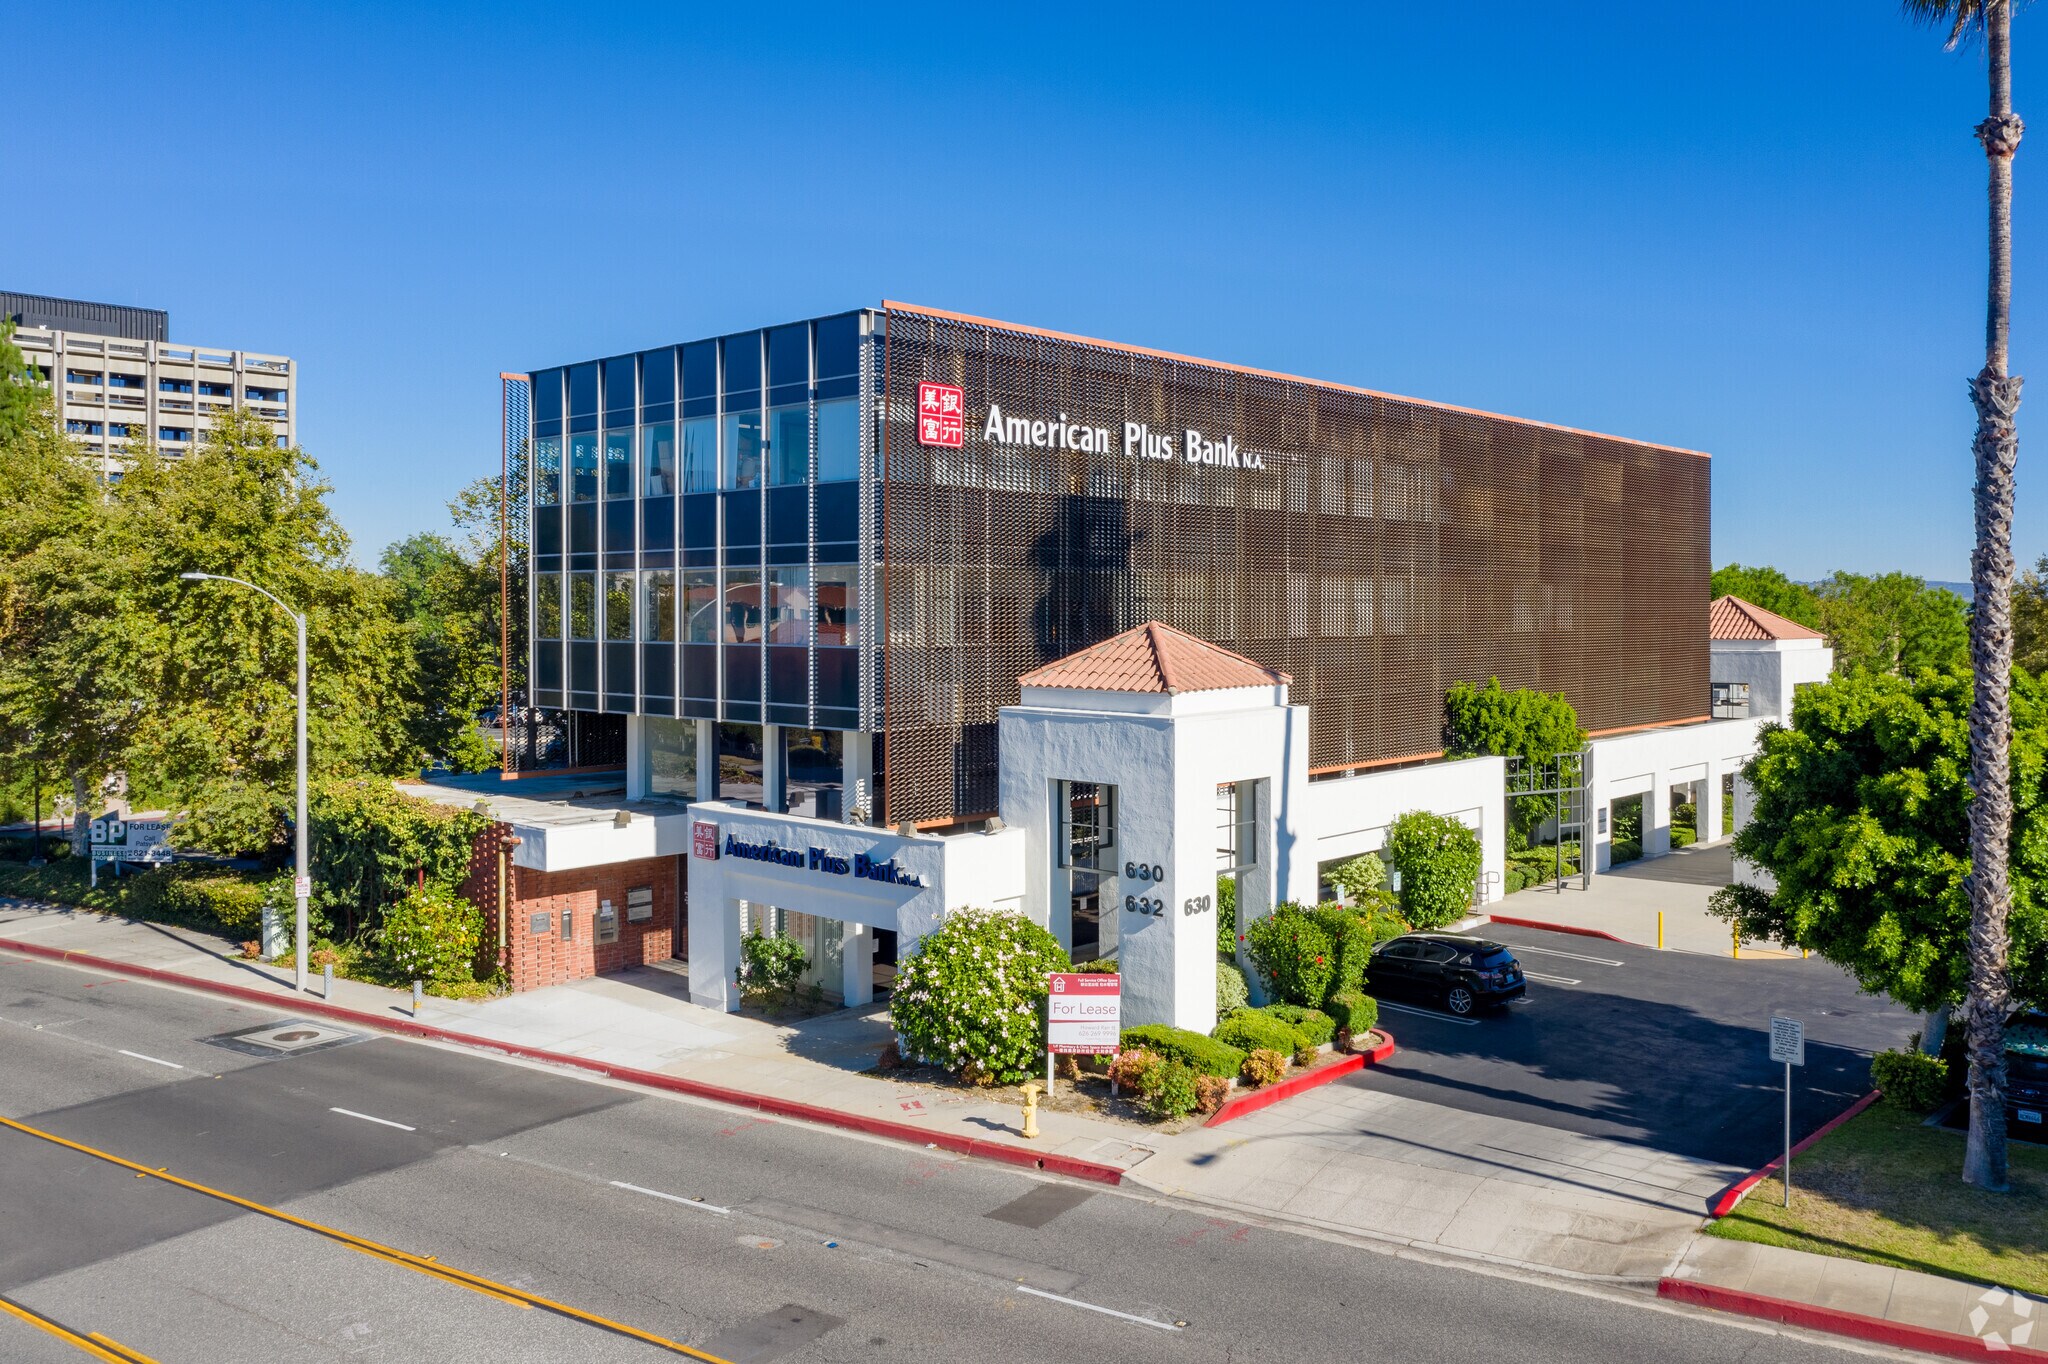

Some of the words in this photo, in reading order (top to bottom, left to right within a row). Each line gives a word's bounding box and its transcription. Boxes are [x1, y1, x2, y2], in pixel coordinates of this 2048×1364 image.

[984, 404, 1109, 453] American
[1123, 421, 1173, 460] Plus
[1184, 429, 1240, 467] Bank
[1242, 452, 1265, 470] N.A.
[92, 820, 125, 843] BP
[129, 823, 145, 831] FOR
[725, 833, 804, 868] American
[808, 847, 850, 875] Plus
[854, 853, 901, 885] Bank
[1125, 861, 1164, 883] 630
[1125, 895, 1164, 918] 632
[1184, 894, 1211, 917] 630
[1053, 1002, 1075, 1014] For
[1080, 1002, 1117, 1015] Lease
